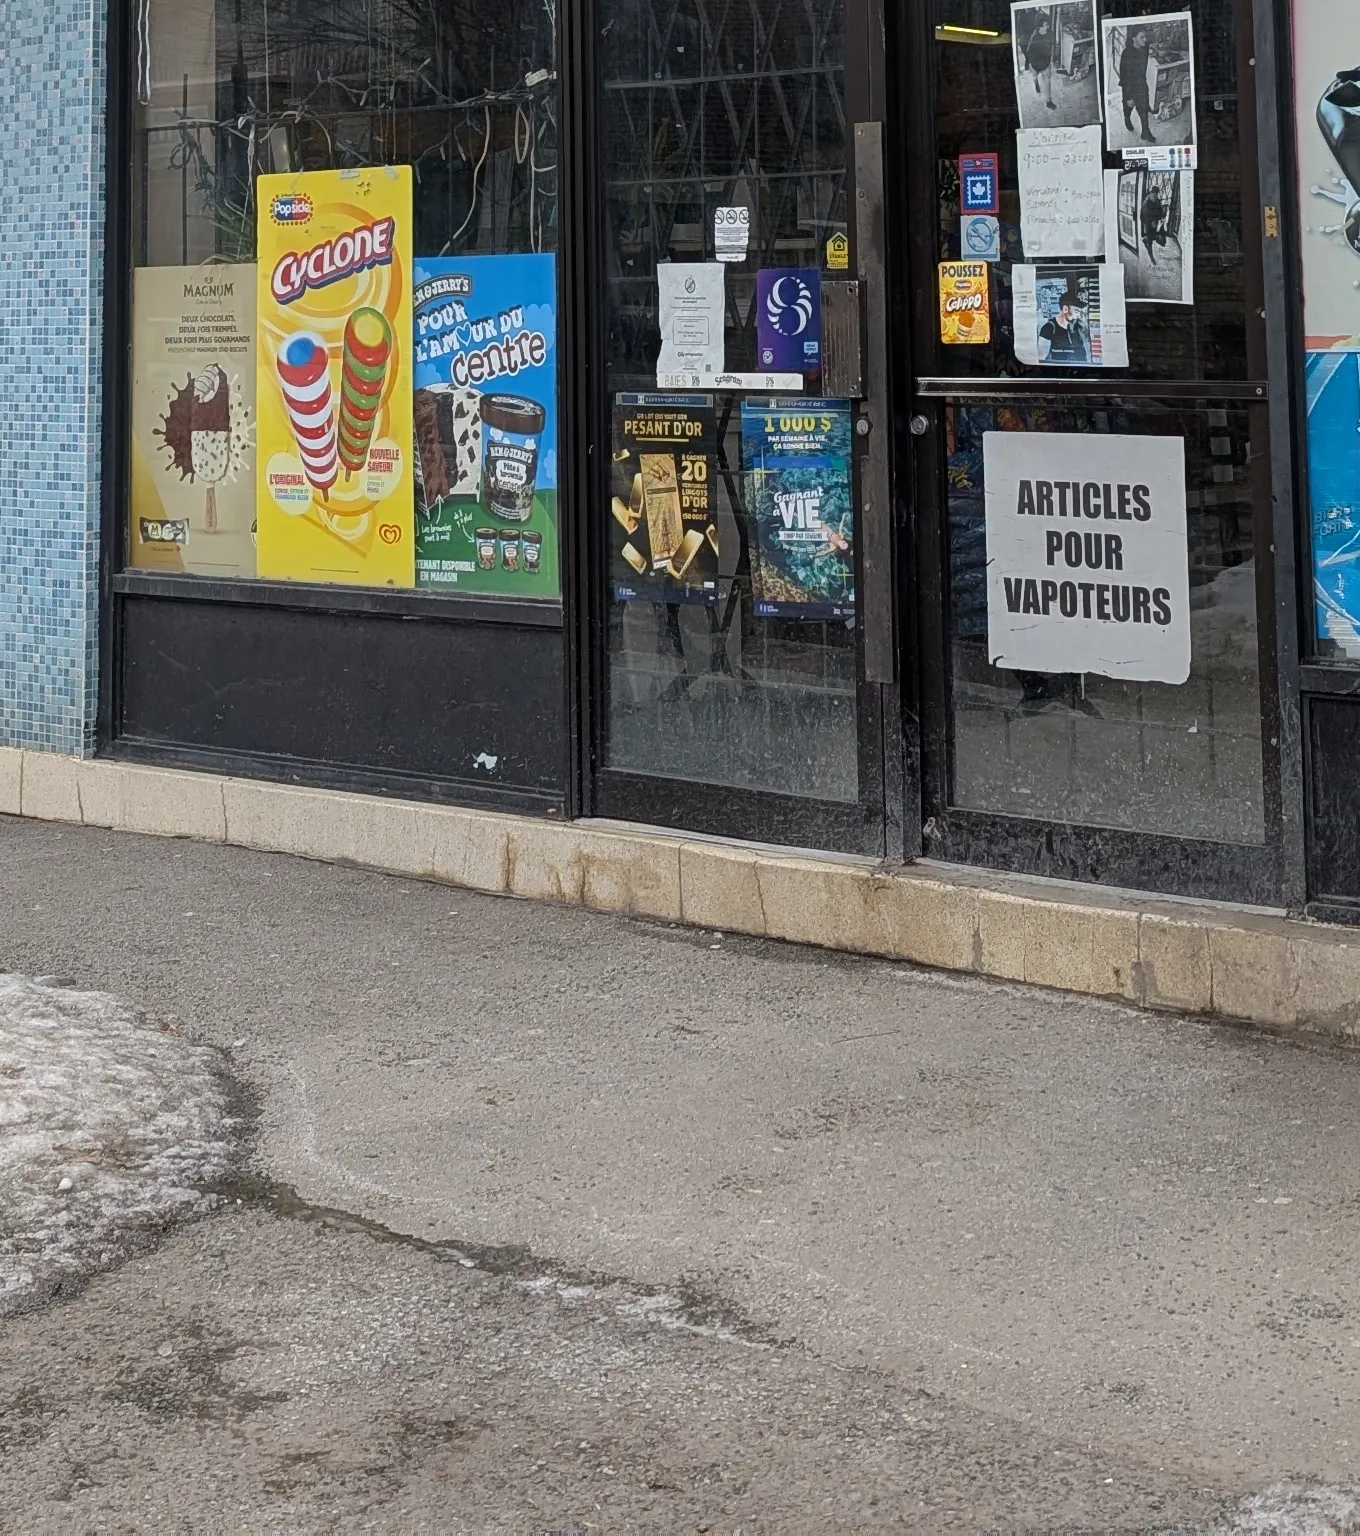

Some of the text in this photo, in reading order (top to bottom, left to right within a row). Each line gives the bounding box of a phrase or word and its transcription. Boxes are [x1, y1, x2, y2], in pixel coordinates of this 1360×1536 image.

[941, 264, 985, 278] POUSSEZ
[183, 282, 235, 298] MAGNUM
[181, 315, 198, 323] DEUX
[416, 299, 469, 336] POUR
[497, 304, 525, 333] DU
[197, 325, 210, 333] FOIS
[183, 336, 197, 344] FOIS
[213, 335, 251, 344] GOURMANDS
[451, 329, 546, 387] centre
[624, 419, 703, 437] PESANT D'OR
[369, 448, 400, 461] NOUVELLE
[367, 461, 394, 473] SAVEUR!
[681, 461, 707, 482] 20
[682, 496, 708, 509] D'OR
[773, 485, 824, 508] Gagnant
[1017, 479, 1152, 522] ARTICLES
[772, 498, 822, 529] à VIE
[1045, 530, 1124, 571] POUR
[441, 560, 476, 572] DISPONIBLE
[420, 572, 458, 582] EN MAGASIN
[1003, 576, 1172, 626] VAPOTEURS
